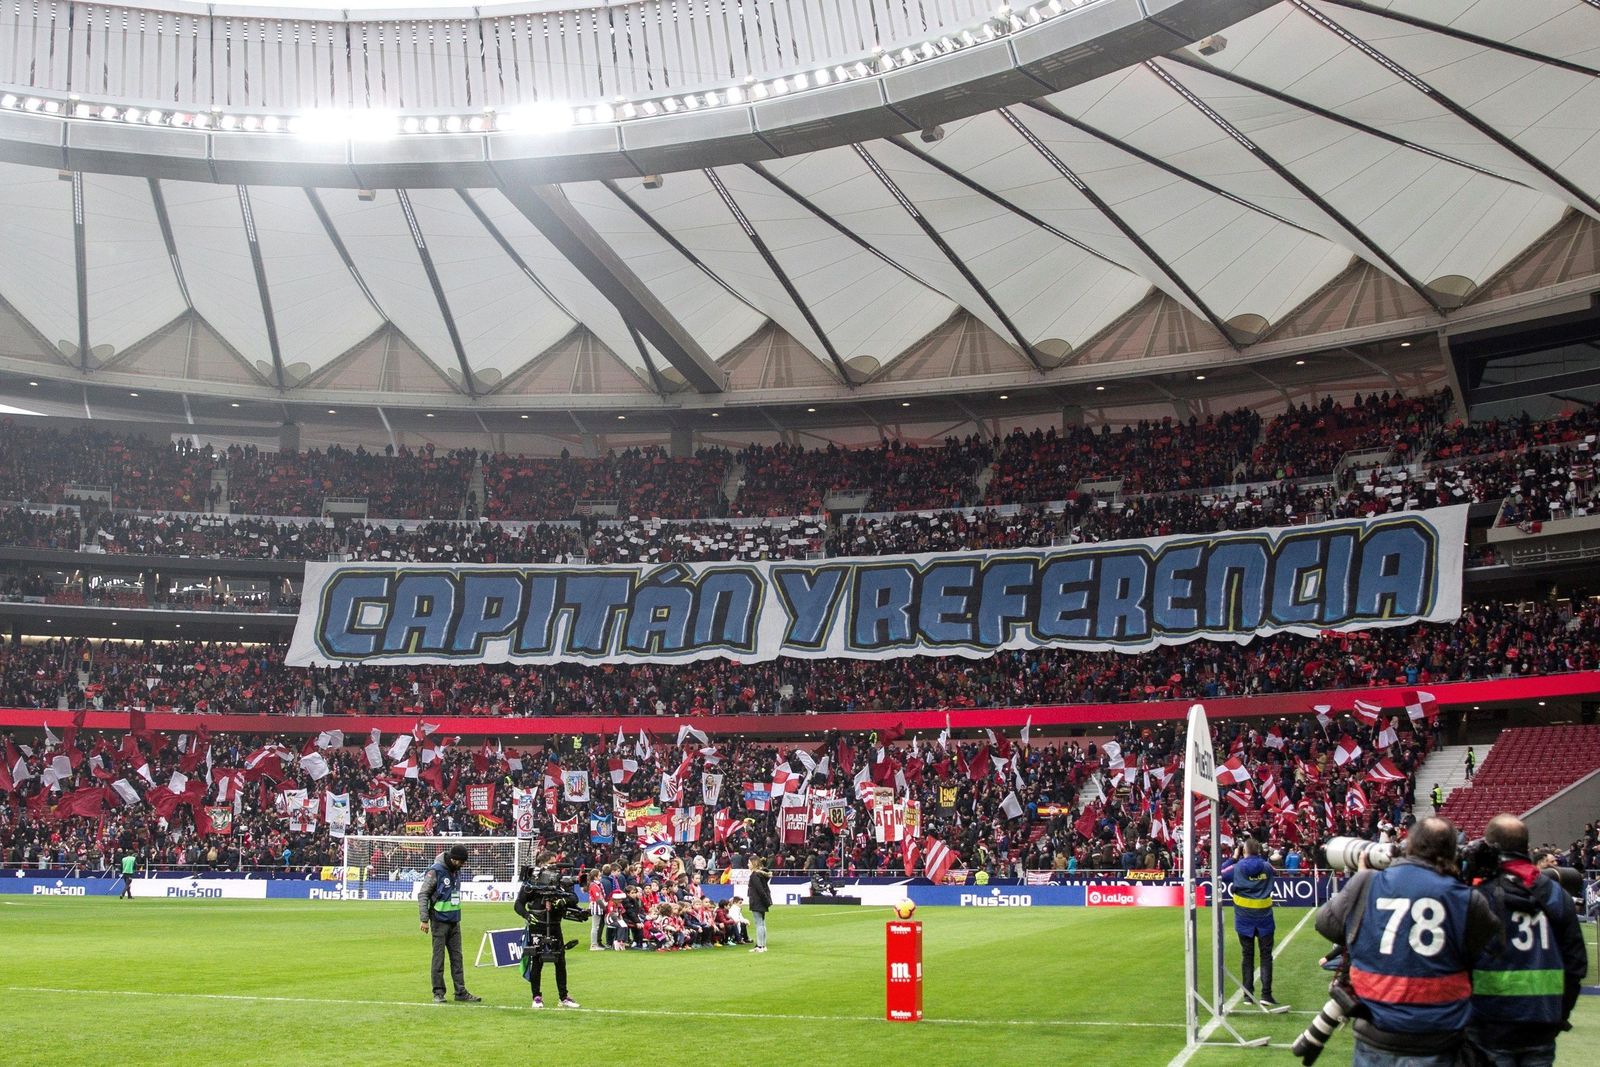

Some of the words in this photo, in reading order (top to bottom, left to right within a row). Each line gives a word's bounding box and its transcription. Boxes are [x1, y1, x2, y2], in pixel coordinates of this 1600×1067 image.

[316, 562, 767, 658] CAPITÁN
[770, 565, 850, 652] Y
[845, 516, 1438, 652] REFERENCIA
[33, 885, 86, 896] Plus500
[167, 887, 222, 898] Plus500
[960, 894, 1032, 906] Plus500
[1376, 897, 1447, 957] 78
[1511, 911, 1549, 951] 31
